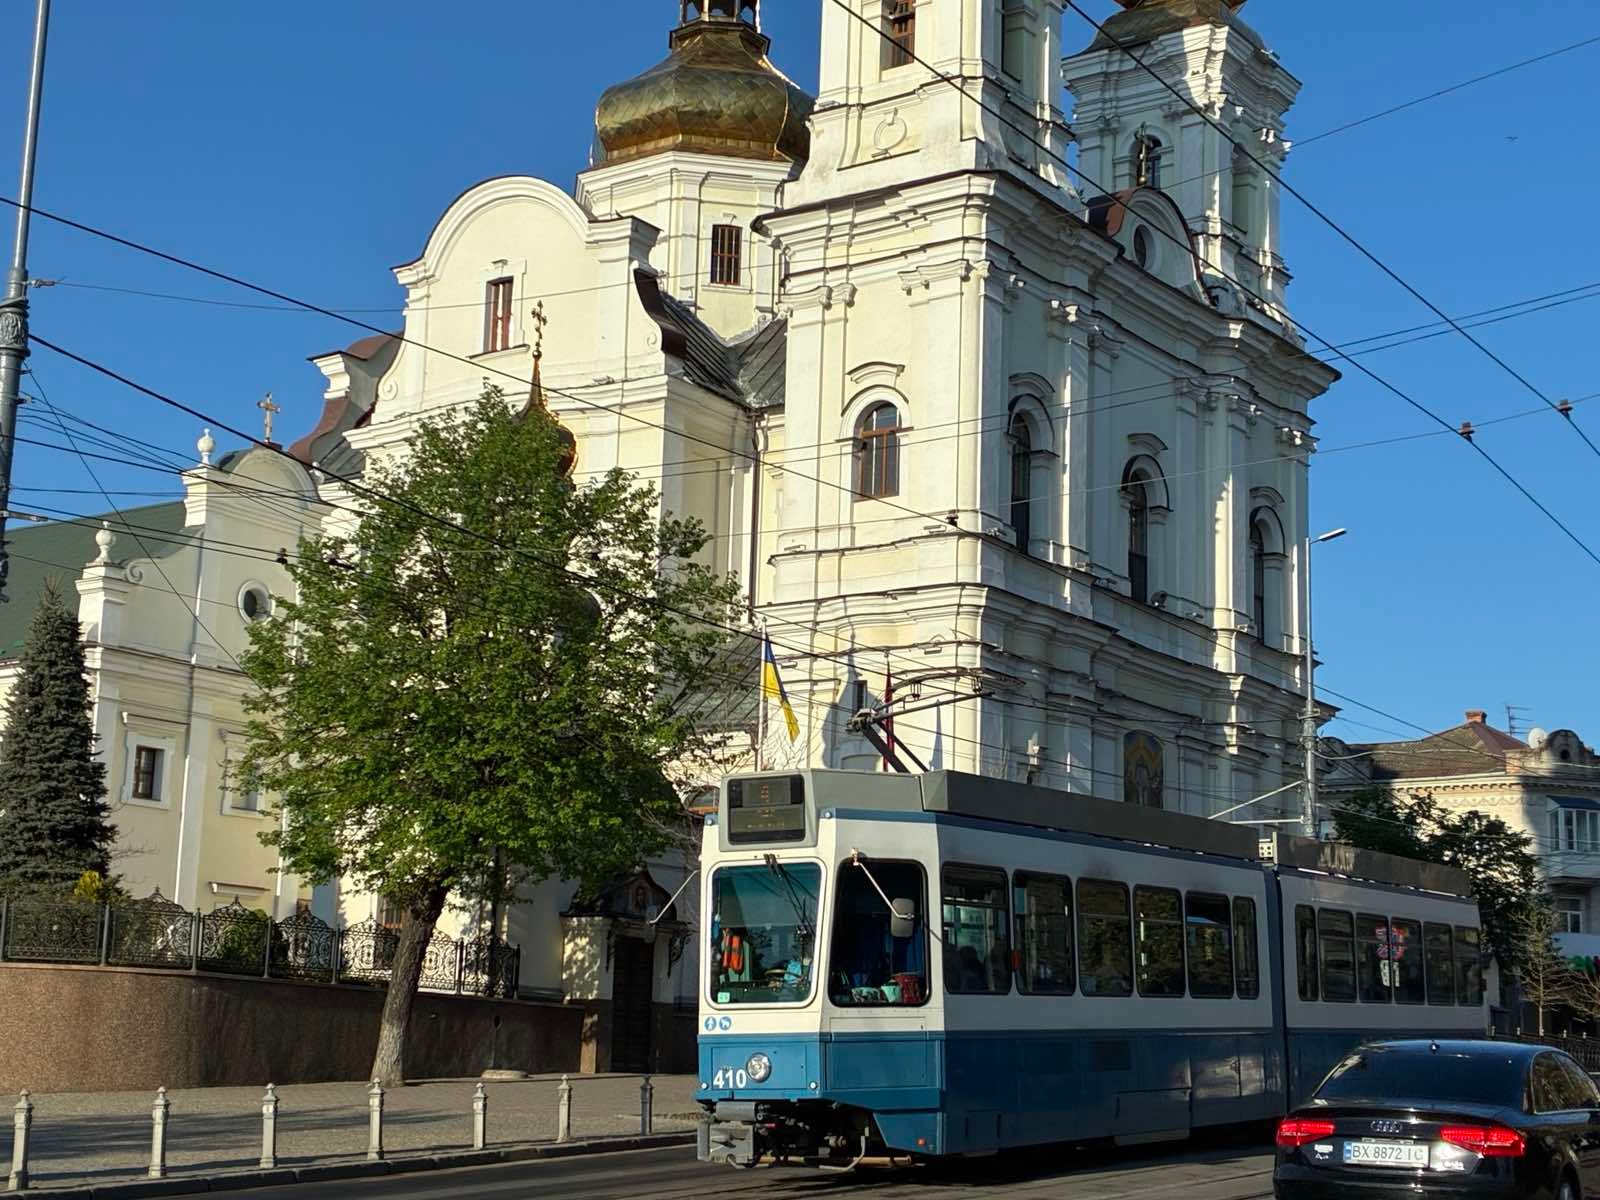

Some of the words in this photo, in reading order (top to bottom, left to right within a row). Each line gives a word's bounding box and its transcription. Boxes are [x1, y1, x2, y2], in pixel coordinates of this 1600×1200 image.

[713, 1069, 747, 1089] 410
[1352, 1145, 1370, 1159] BX
[1373, 1146, 1402, 1160] 8872
